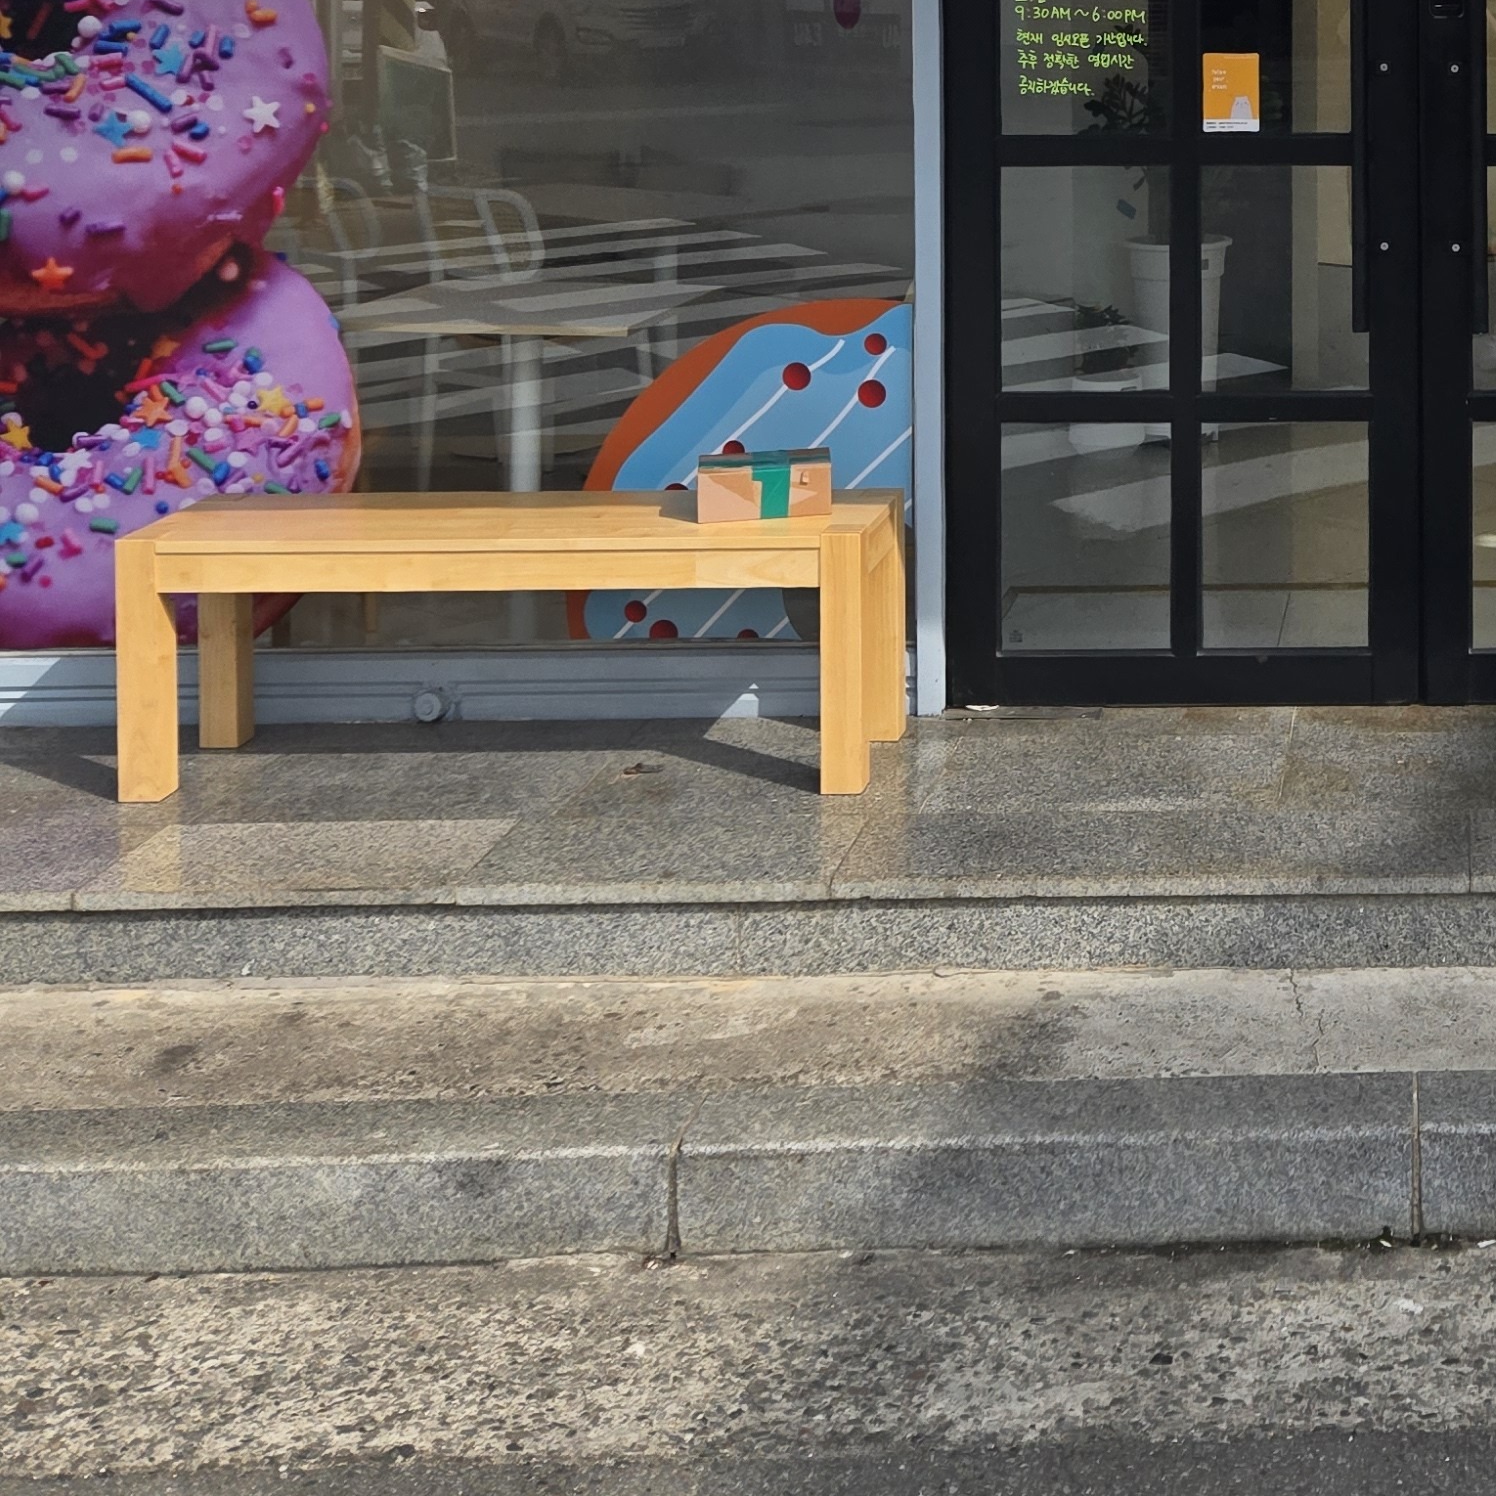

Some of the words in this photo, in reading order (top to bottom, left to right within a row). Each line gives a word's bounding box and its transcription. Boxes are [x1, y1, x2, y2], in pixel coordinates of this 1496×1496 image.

[1016, 28, 1043, 45] 현재
[1017, 49, 1038, 70] 추후
[1043, 51, 1080, 70] 정확한
[1087, 53, 1135, 69] 영업시간
